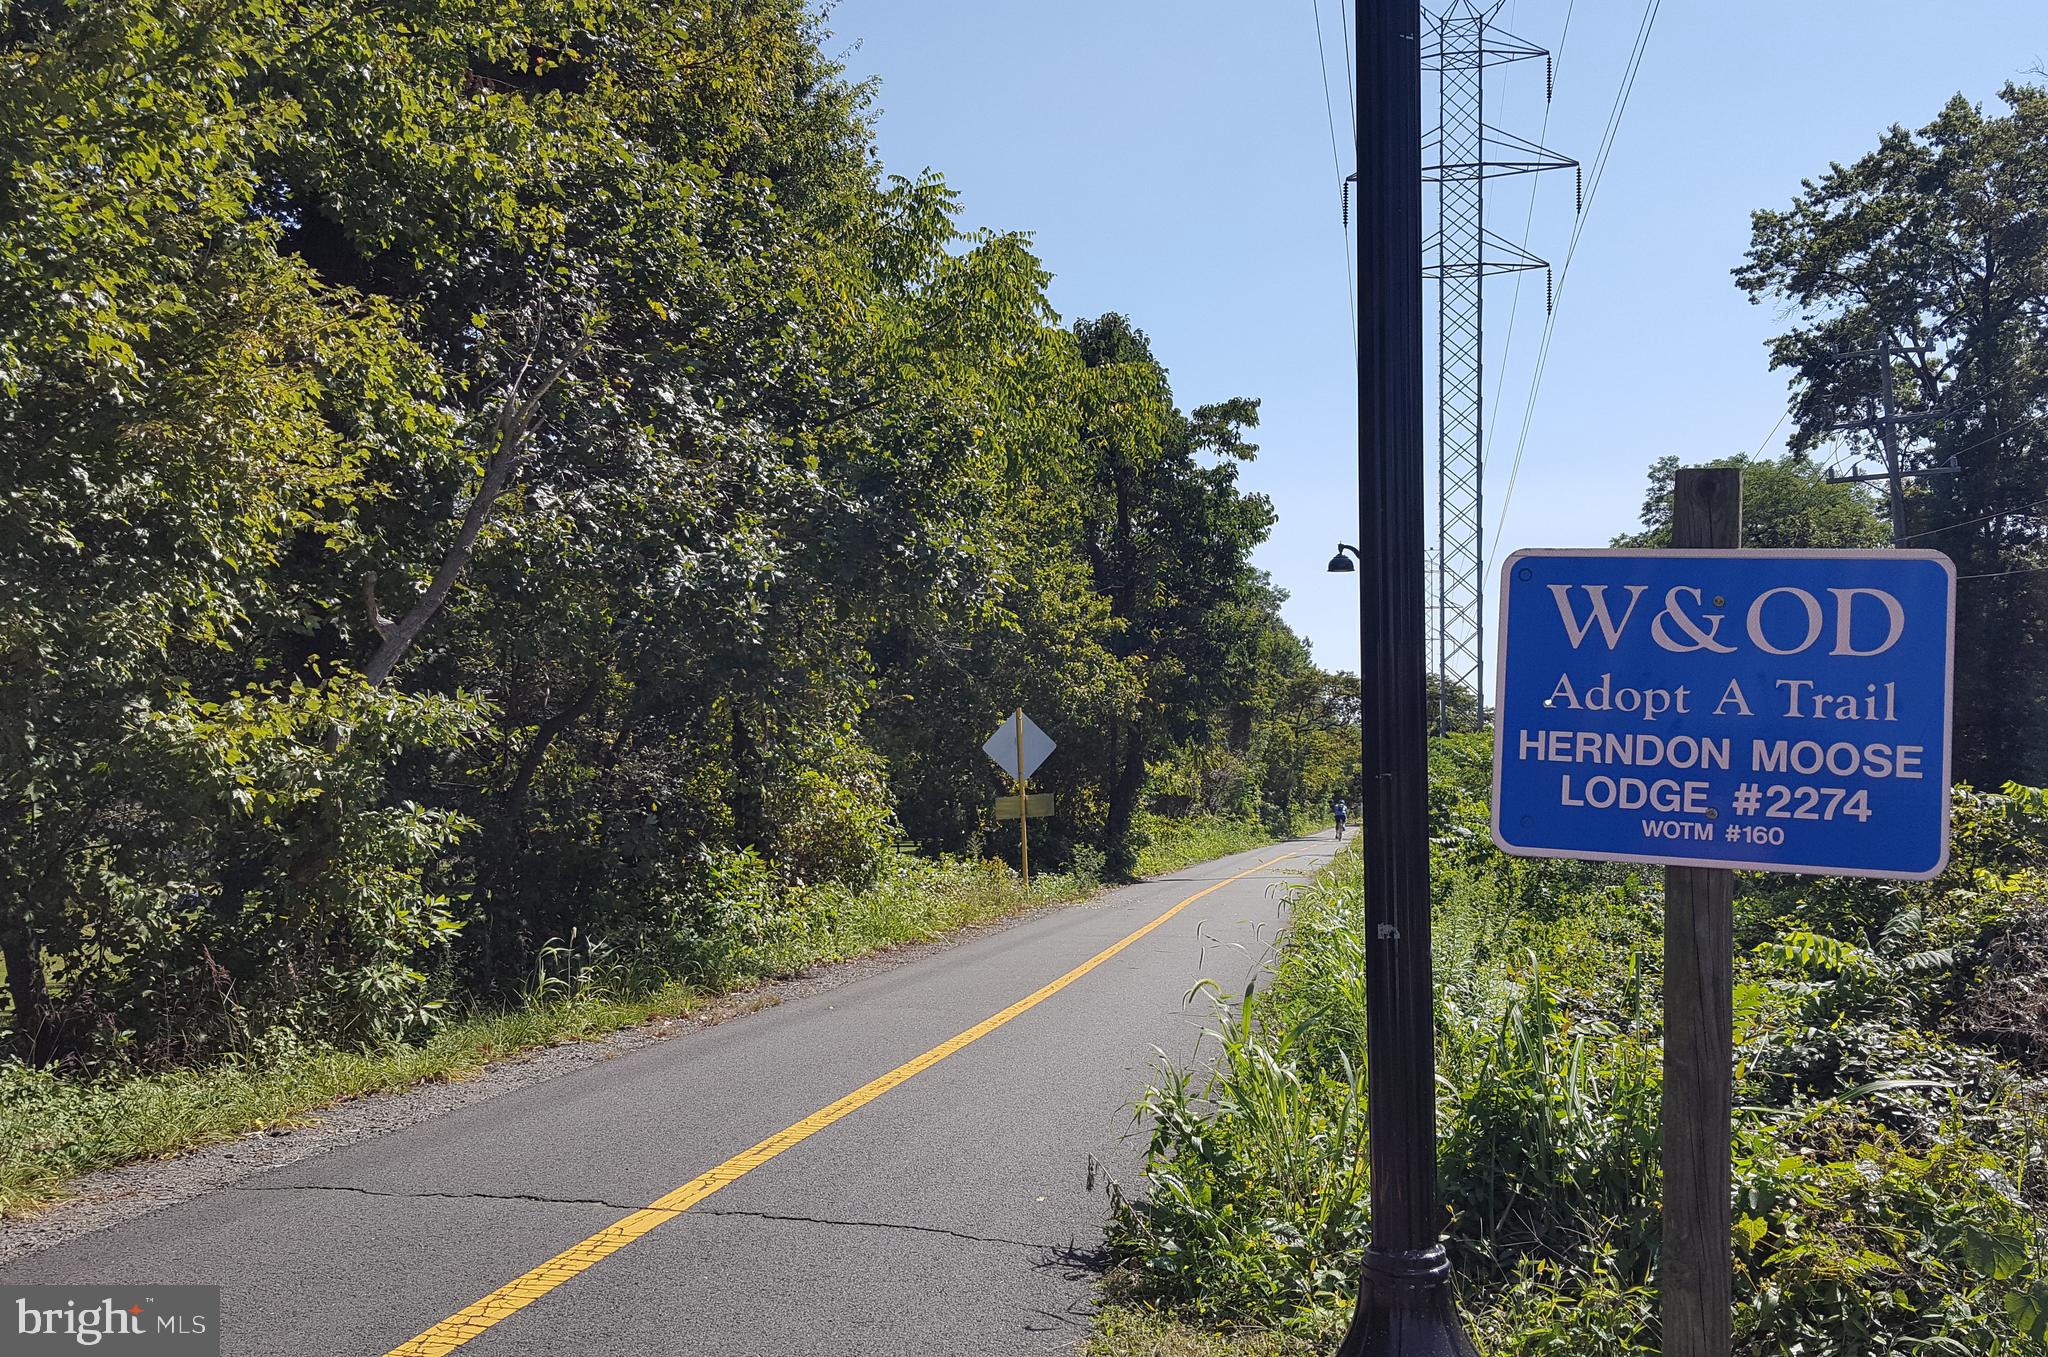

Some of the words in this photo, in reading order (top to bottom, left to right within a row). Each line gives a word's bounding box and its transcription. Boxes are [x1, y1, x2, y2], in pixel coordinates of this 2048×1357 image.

[1545, 583, 1905, 657] W&OD
[1542, 672, 1691, 721] Adopt
[1712, 677, 1756, 717] A
[1775, 679, 1899, 722] Trail
[1518, 728, 1731, 771] HERNDON
[1751, 738, 1925, 780] MOOSE
[1560, 773, 1711, 814] LODGE
[1732, 782, 1873, 823] #2274
[1641, 818, 1714, 842] WOTM
[1724, 824, 1786, 847] #160
